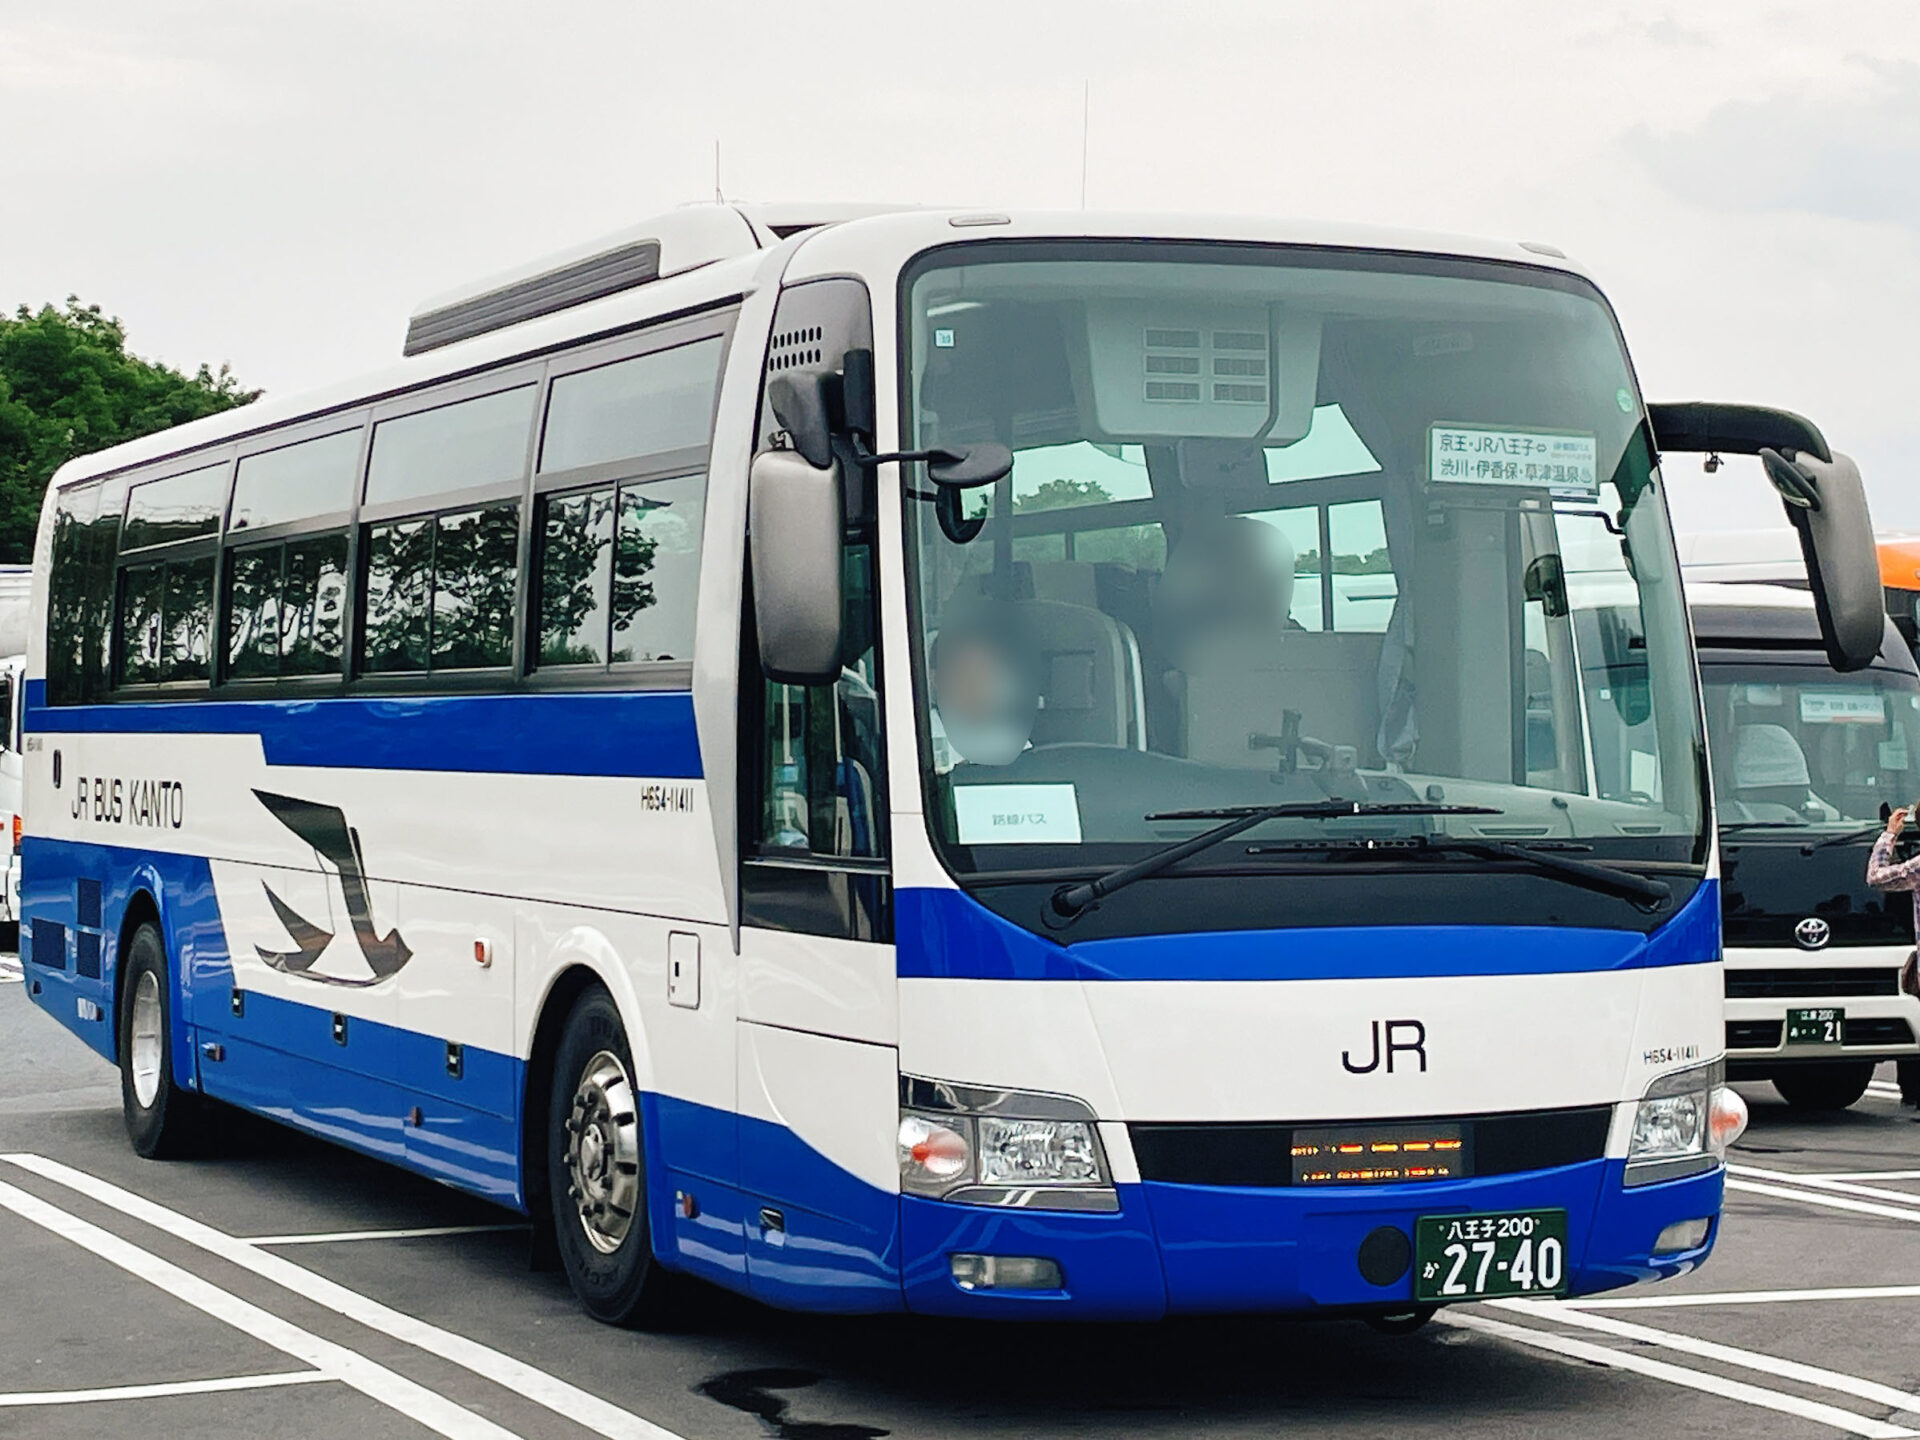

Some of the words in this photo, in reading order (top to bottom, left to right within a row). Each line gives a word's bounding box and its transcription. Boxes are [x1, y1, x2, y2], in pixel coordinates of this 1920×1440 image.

[71, 776, 89, 821] JR
[95, 777, 123, 824] BUS
[129, 779, 183, 829] KANTO
[1342, 1020, 1427, 1074] JR
[1824, 1021, 1841, 1041] 21
[1422, 1262, 1440, 1279] か
[1442, 1237, 1562, 1295] 27-40
